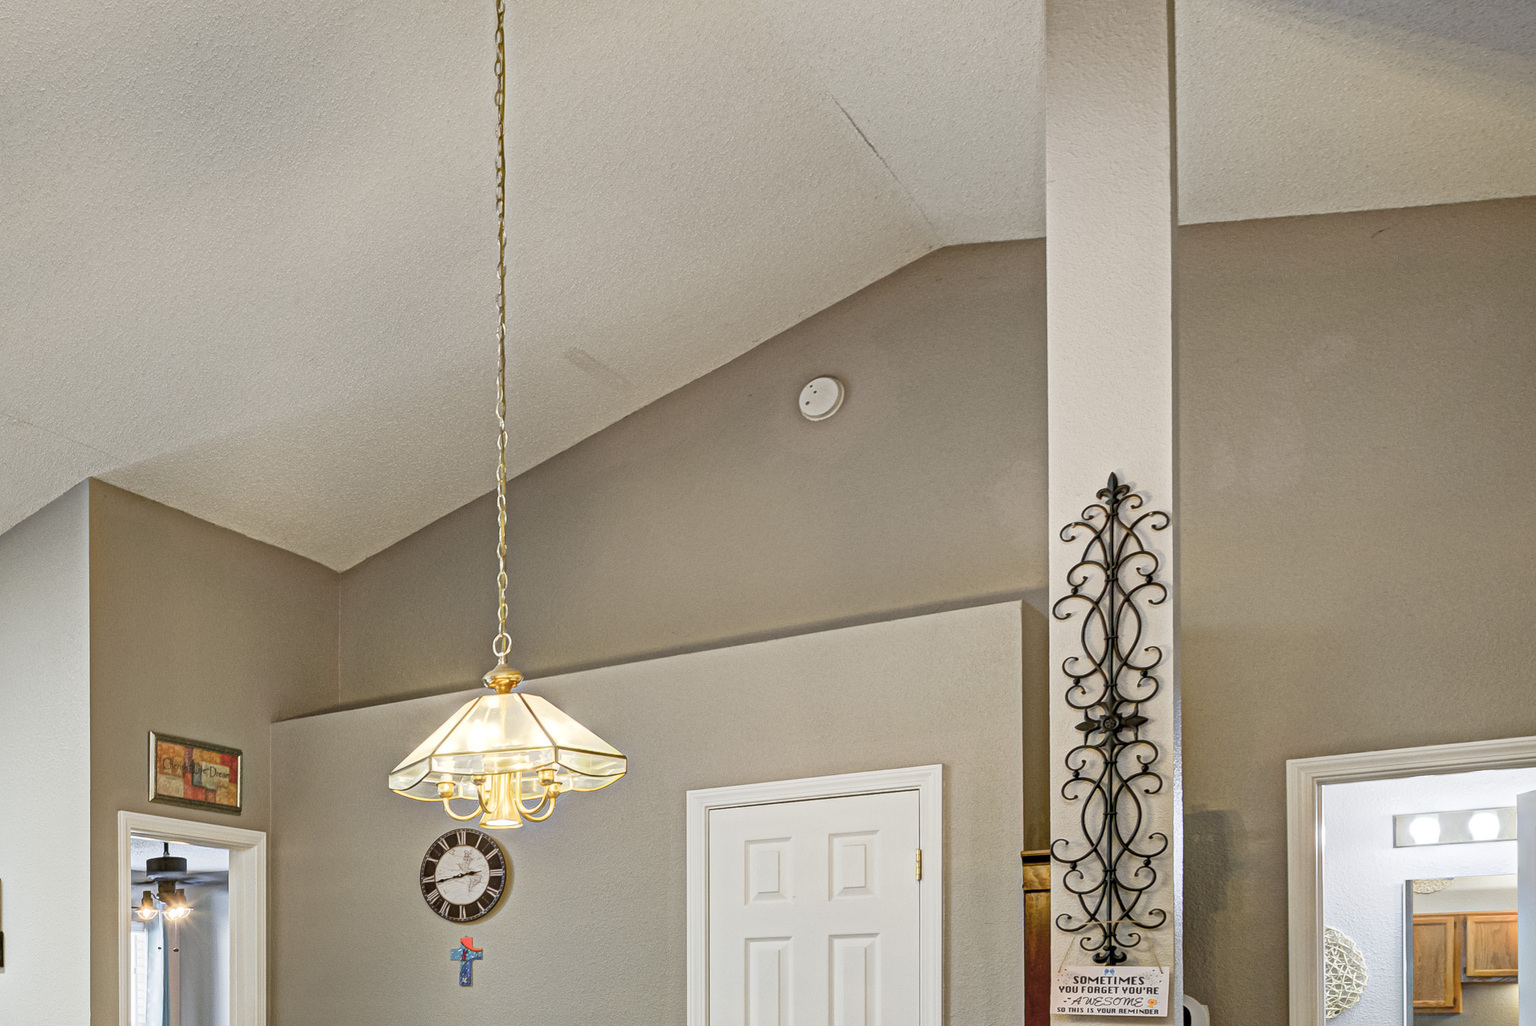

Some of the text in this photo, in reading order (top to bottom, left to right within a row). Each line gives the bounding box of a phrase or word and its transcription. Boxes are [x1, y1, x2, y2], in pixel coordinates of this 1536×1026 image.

[1073, 975, 1145, 985] SOMETIMES
[1058, 986, 1160, 995] YOU FORGET YOU'RE
[1071, 996, 1144, 1007] AWESOME
